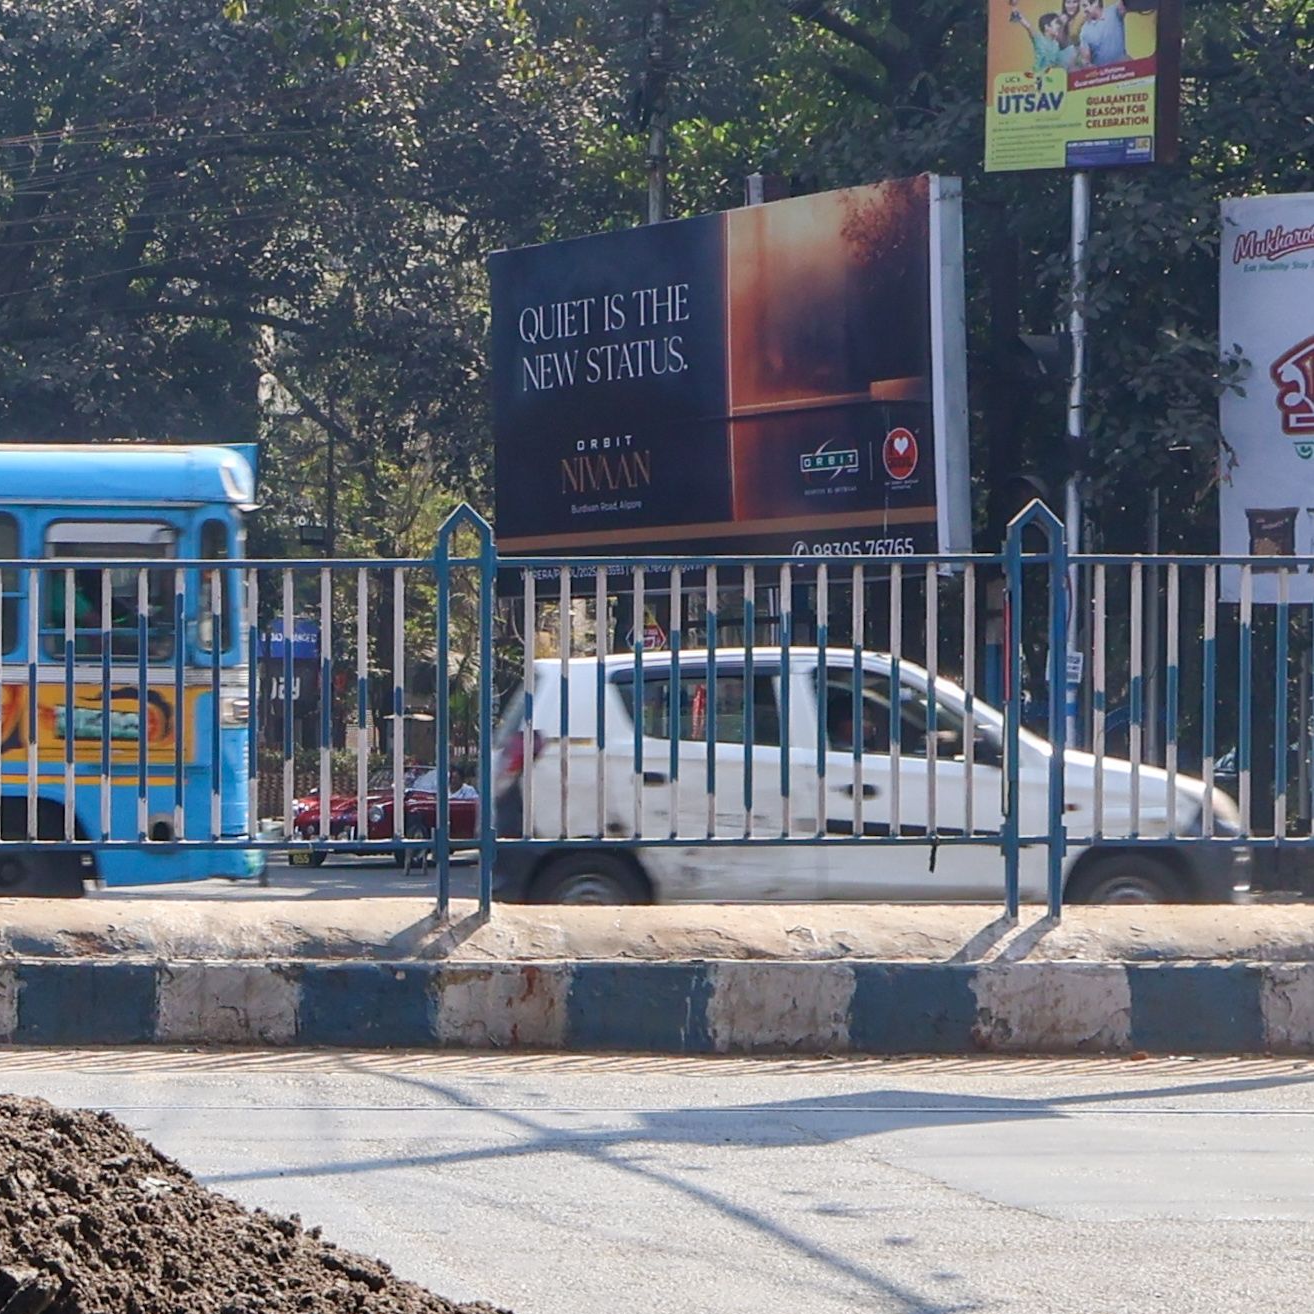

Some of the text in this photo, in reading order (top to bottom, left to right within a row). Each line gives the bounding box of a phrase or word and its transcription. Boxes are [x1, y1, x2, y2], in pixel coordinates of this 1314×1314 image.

[997, 90, 1064, 115] UTSAV
[1086, 92, 1149, 106] GUARANTEED
[1086, 103, 1146, 118] REASON FOR
[1086, 115, 1150, 129] CELEBRATION
[519, 283, 690, 344] QUIET IS THE
[523, 335, 689, 392] NEW STATUS.
[576, 435, 633, 451] ORBIT
[803, 454, 855, 468] ORBIT
[561, 450, 651, 495] NIVAAN
[865, 538, 915, 556] 76765
